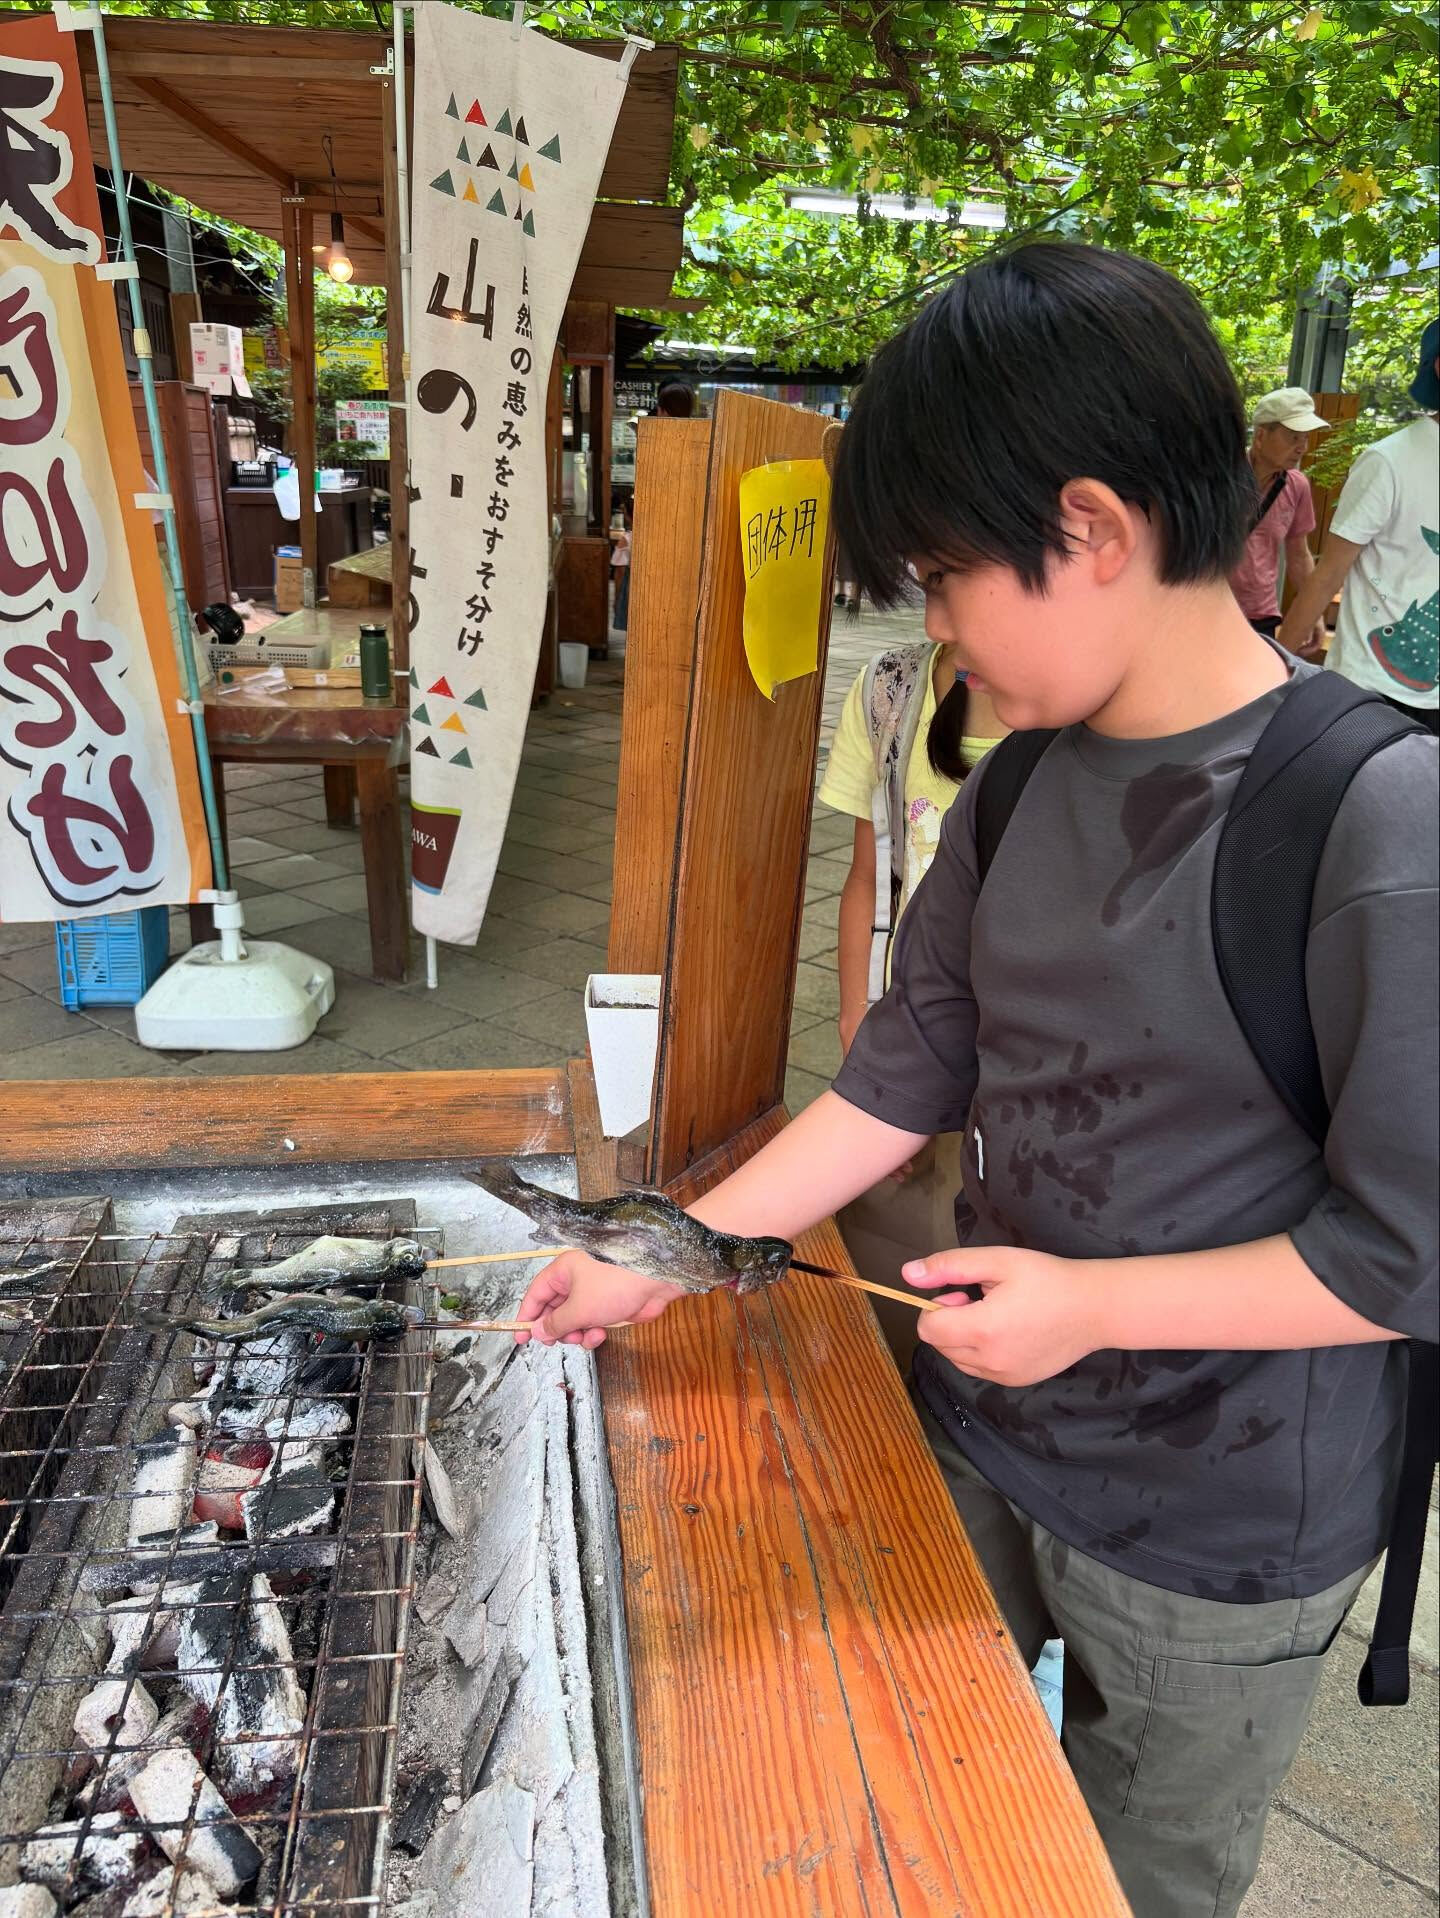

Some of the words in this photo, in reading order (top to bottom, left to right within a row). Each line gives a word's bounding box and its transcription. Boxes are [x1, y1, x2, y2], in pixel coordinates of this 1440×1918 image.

[614, 381, 652, 391] CASHIER
[748, 498, 817, 579] 団体用
